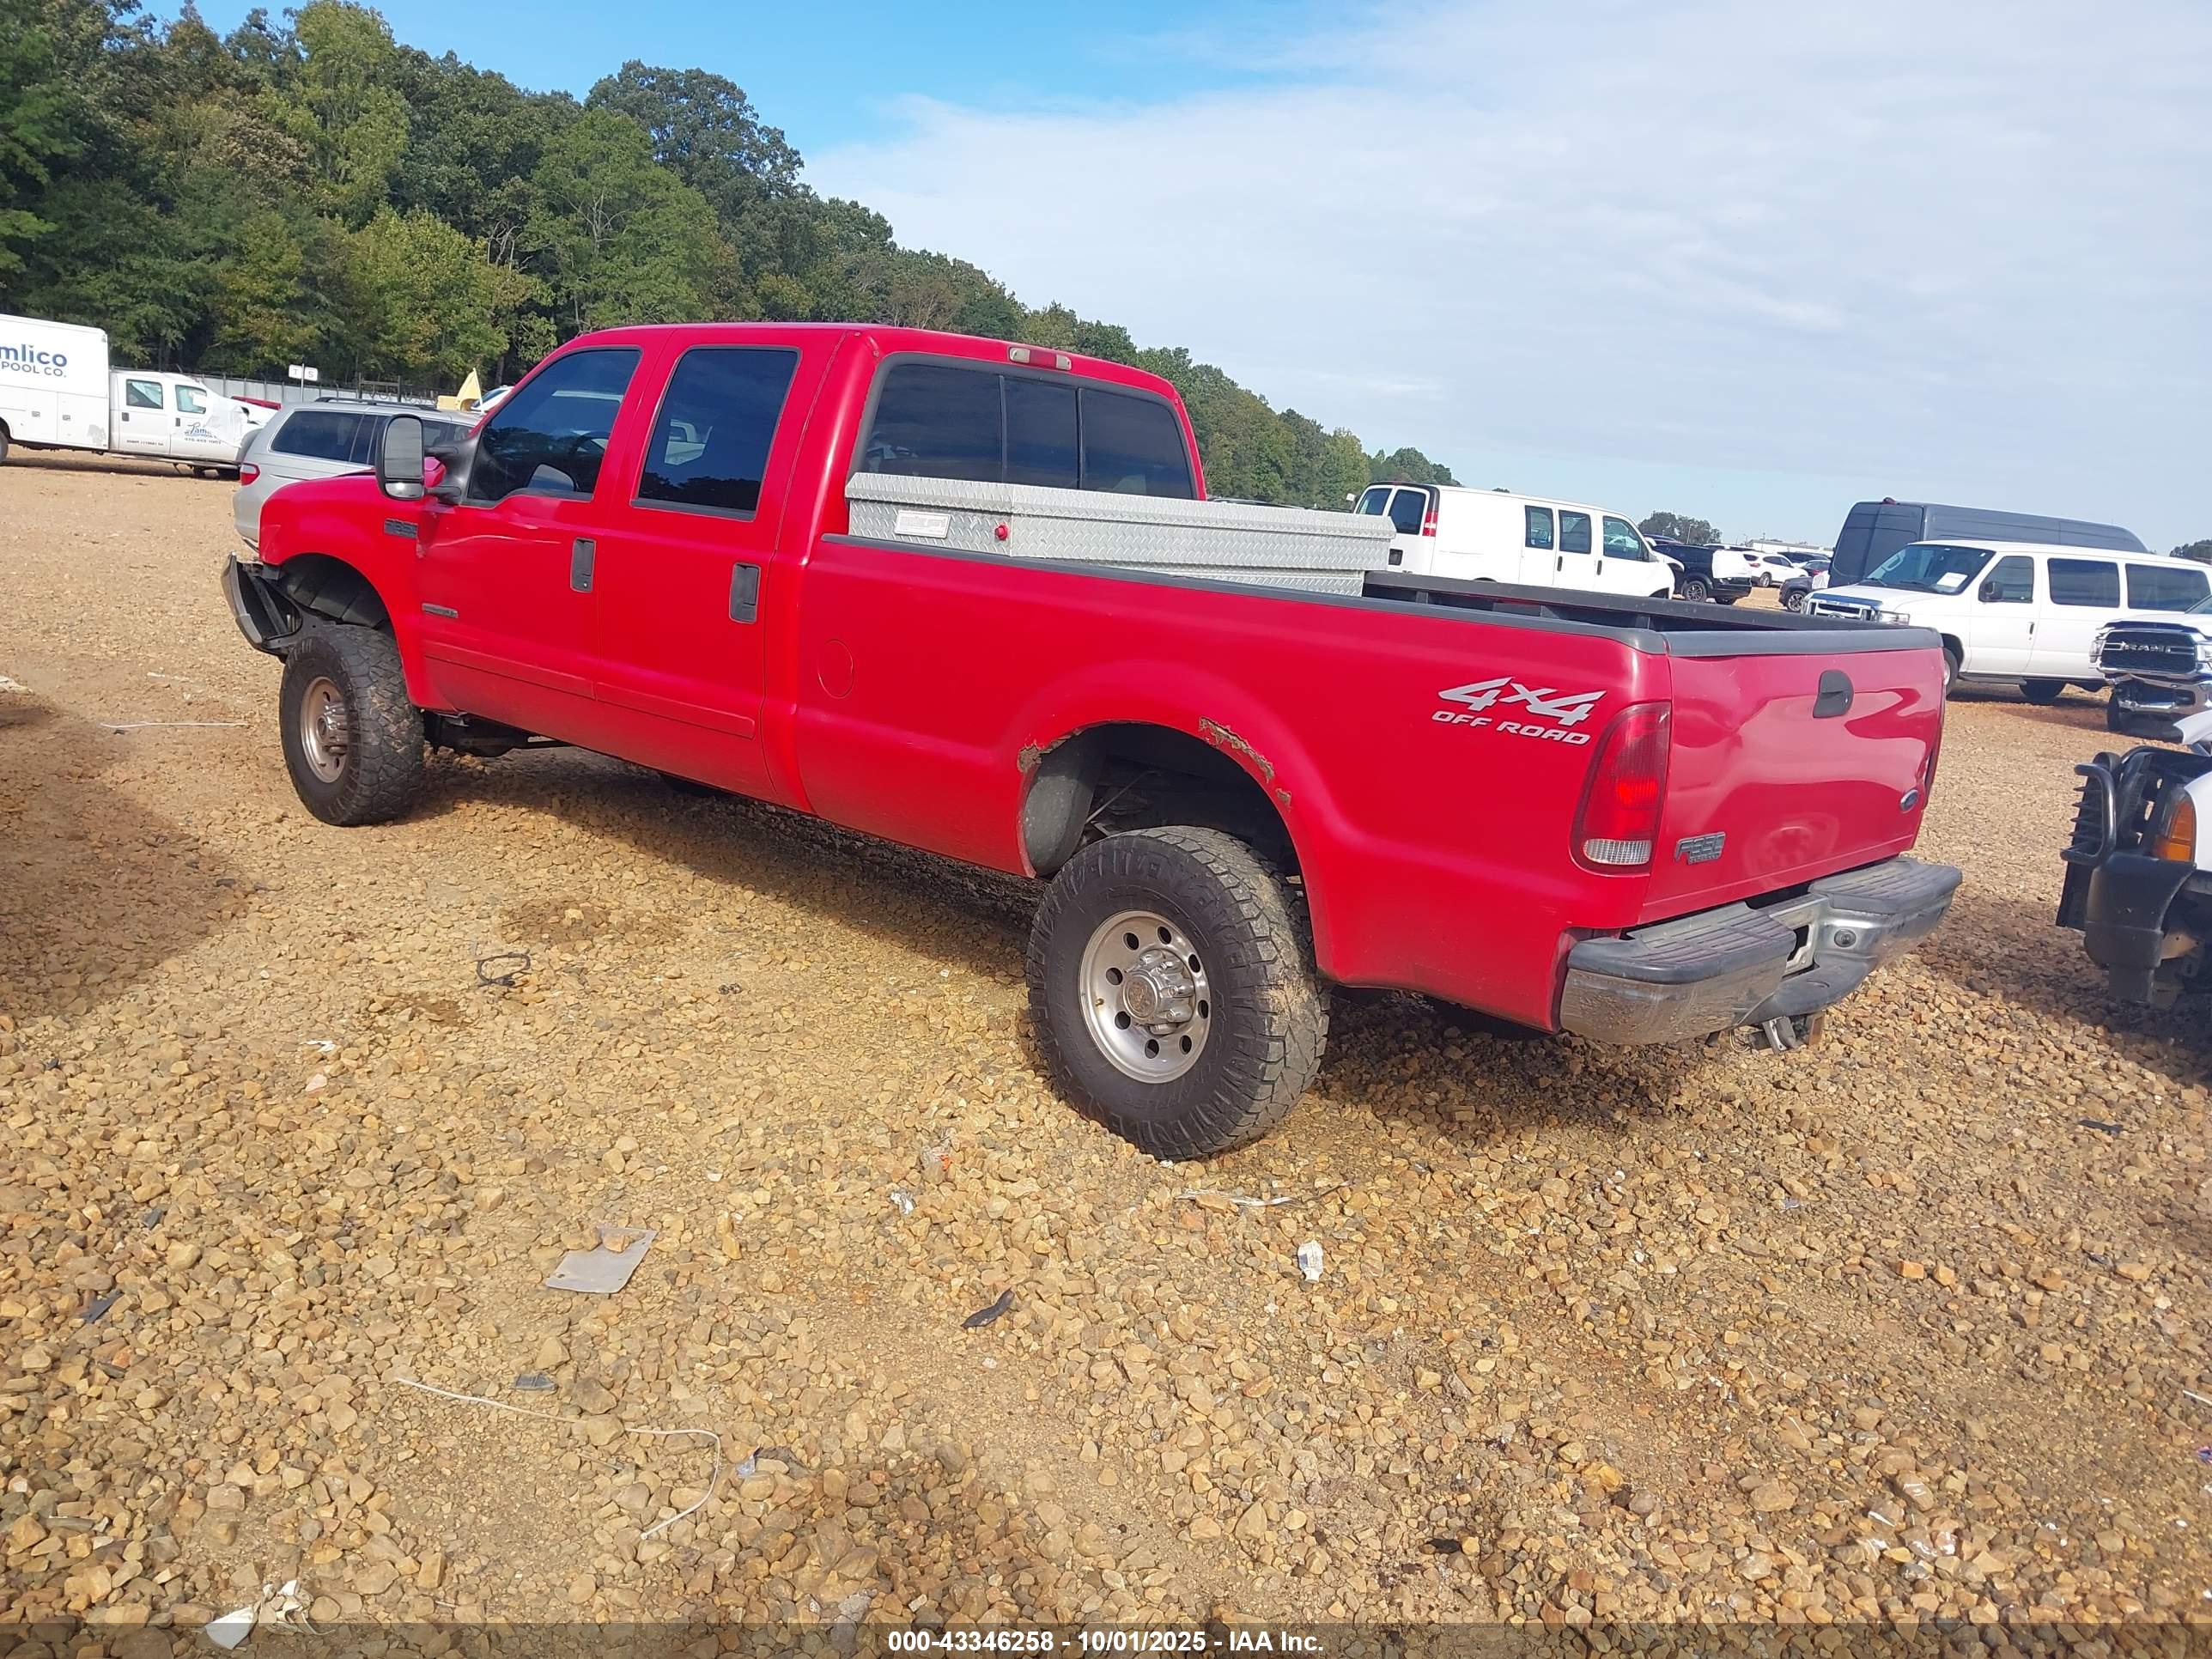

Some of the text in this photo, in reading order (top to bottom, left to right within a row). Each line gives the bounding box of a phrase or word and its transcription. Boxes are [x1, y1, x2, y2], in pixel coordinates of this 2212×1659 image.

[0, 343, 68, 367] mlico
[2, 361, 67, 378] POOL CO.
[1431, 710, 1590, 745] OFF ROAD
